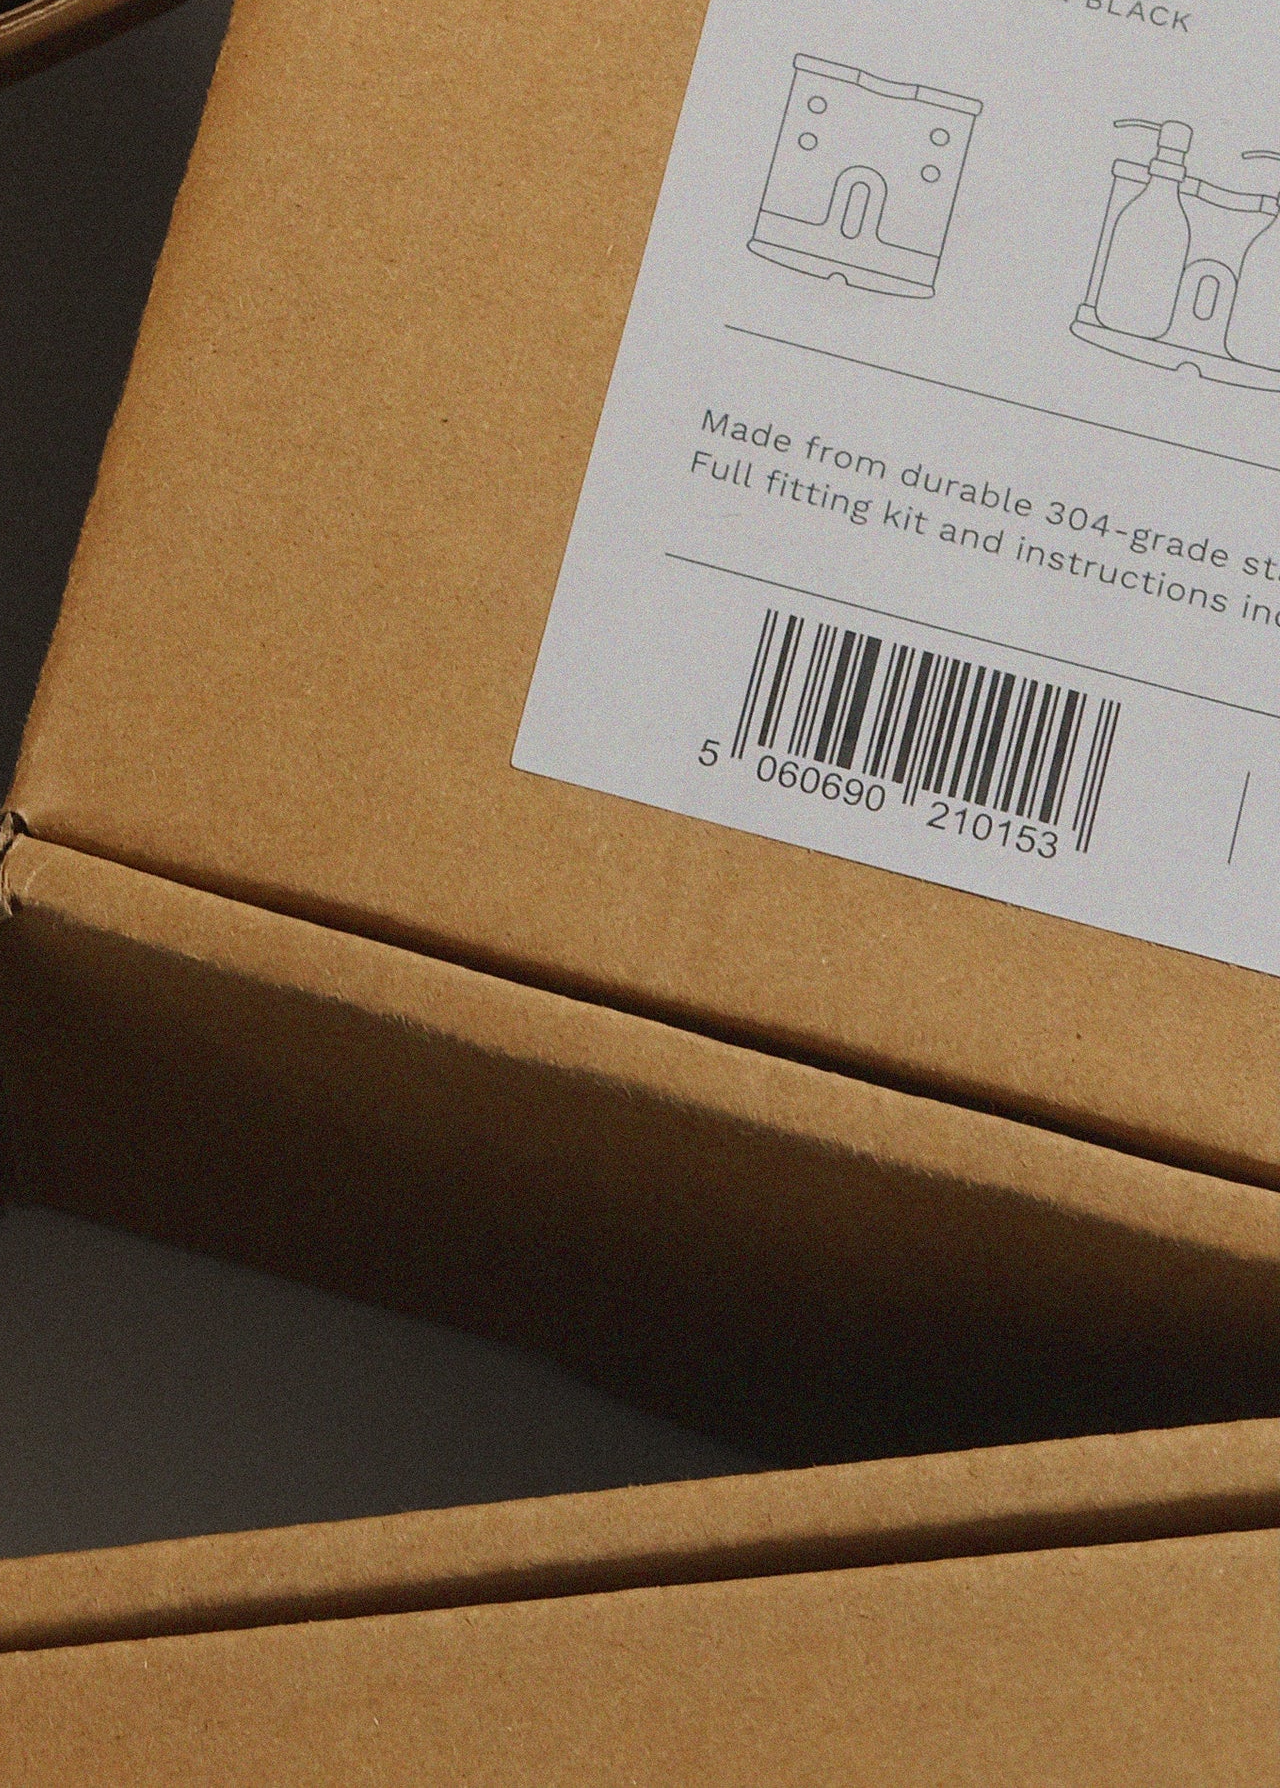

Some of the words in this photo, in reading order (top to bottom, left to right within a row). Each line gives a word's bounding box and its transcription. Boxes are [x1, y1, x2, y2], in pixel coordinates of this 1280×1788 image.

[689, 449, 753, 489] Full
[766, 468, 873, 527] fitting
[882, 499, 929, 536] kit
[938, 522, 1005, 555] and
[1015, 535, 1229, 614] instructions
[700, 407, 793, 454] Made
[805, 434, 887, 480] from
[900, 462, 1033, 518] durable
[1044, 500, 1230, 569] 304-grade
[697, 737, 721, 768] 5
[755, 754, 886, 813] 060690
[925, 801, 1059, 860] 210153
